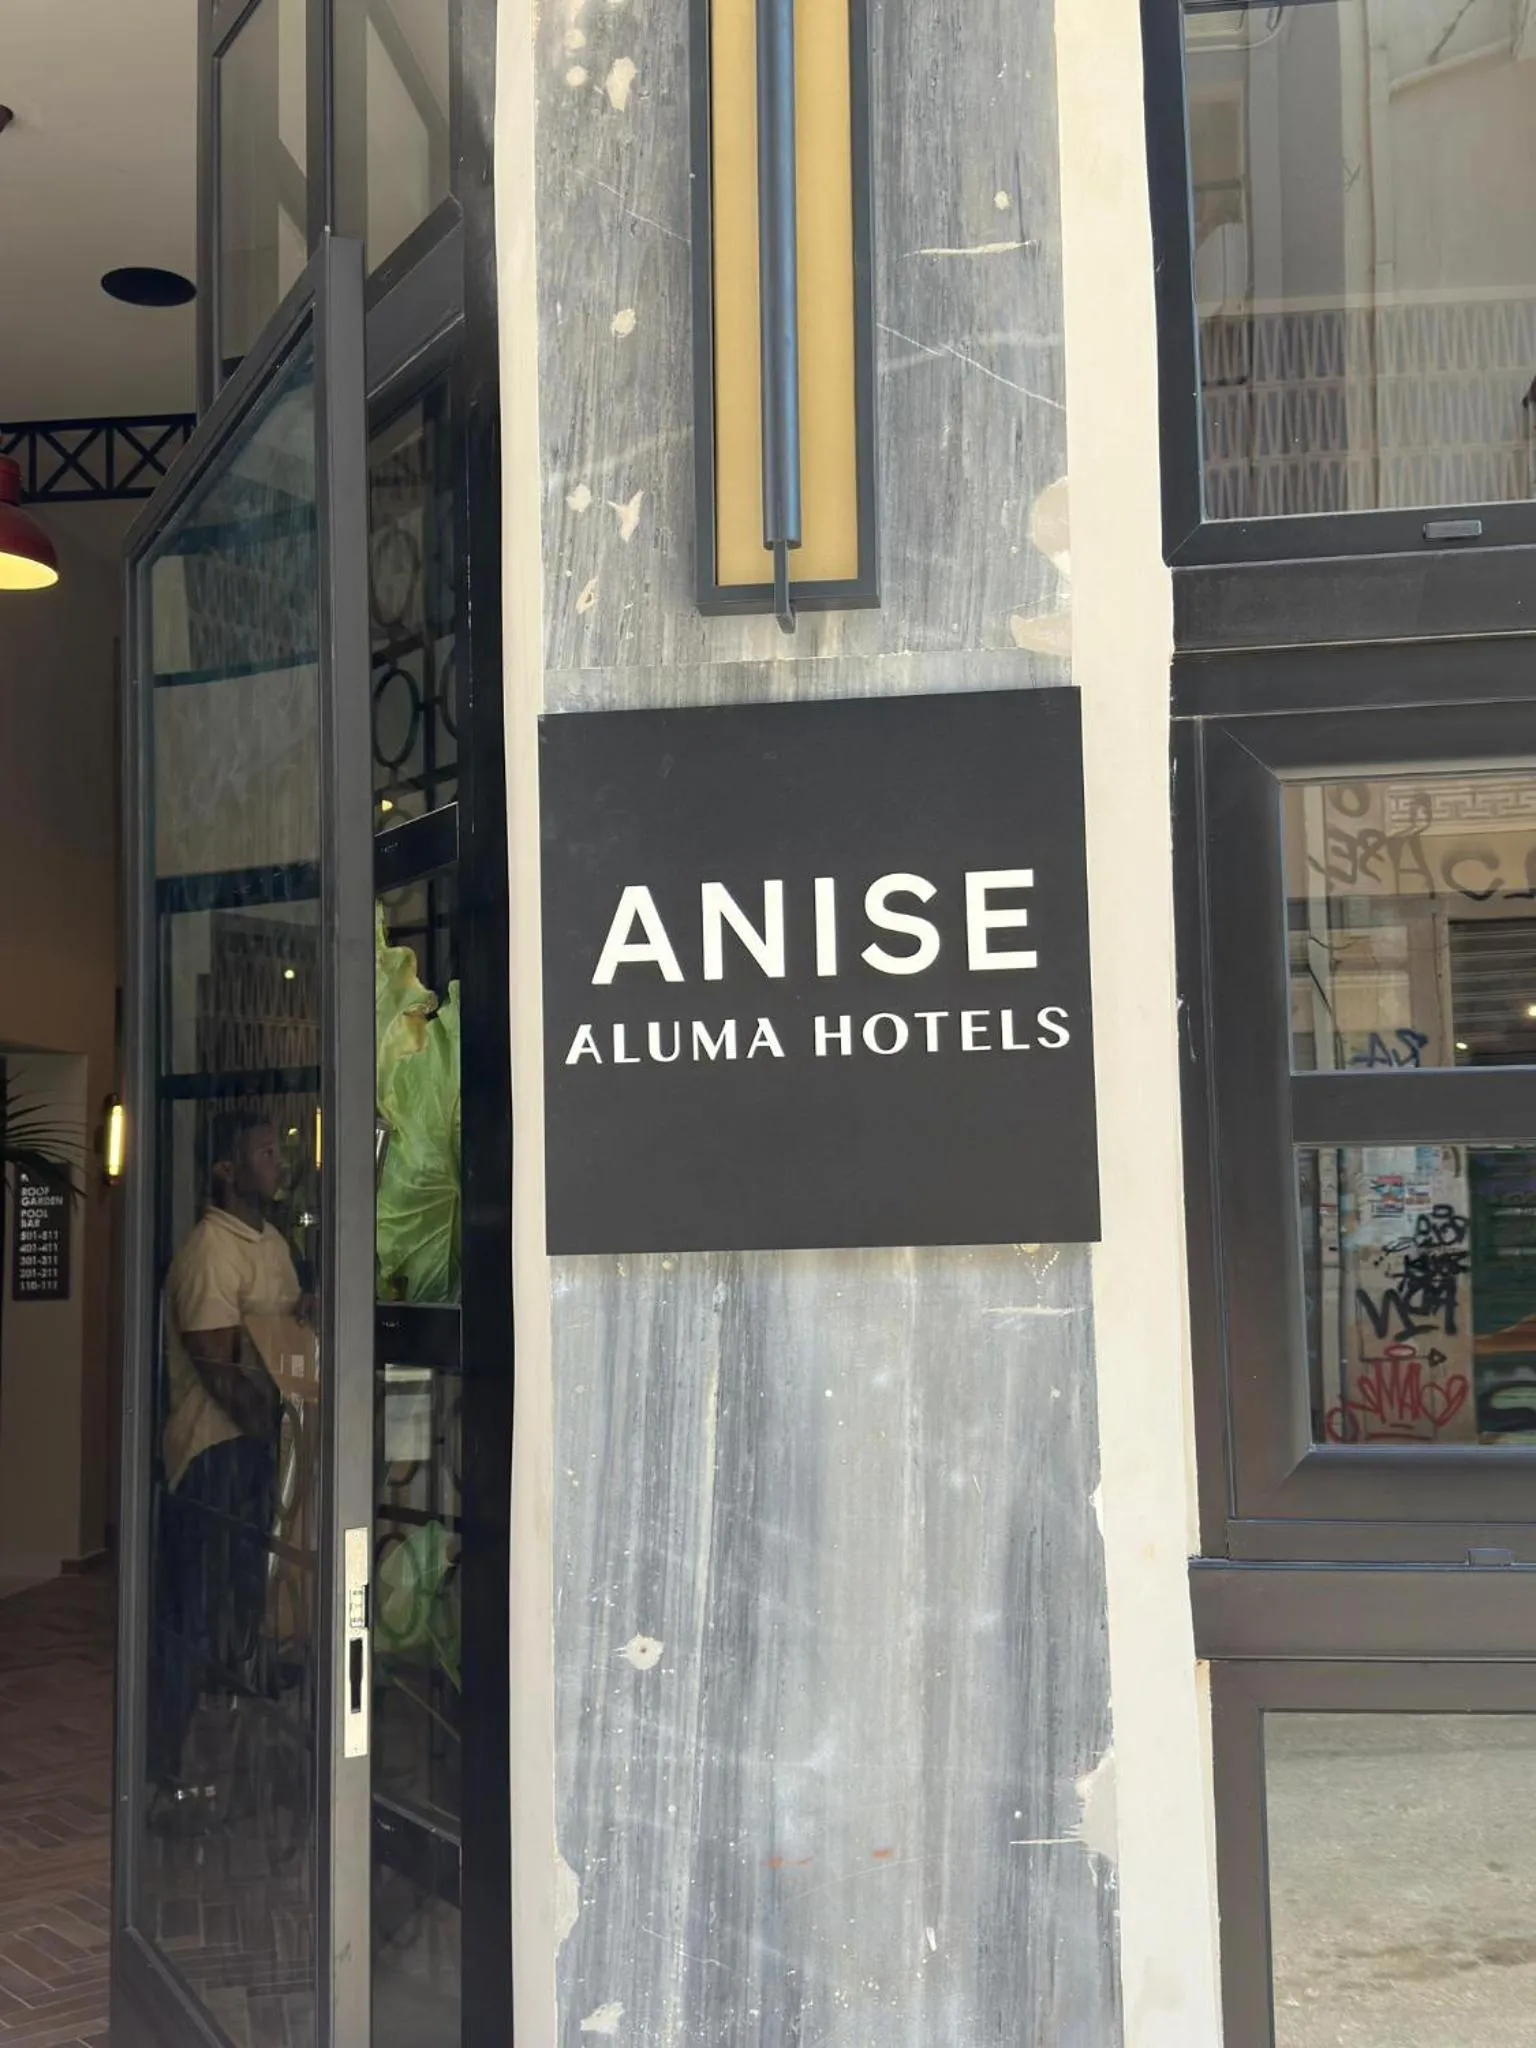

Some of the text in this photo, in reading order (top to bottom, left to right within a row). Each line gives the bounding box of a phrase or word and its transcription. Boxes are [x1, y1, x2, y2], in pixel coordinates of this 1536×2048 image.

[592, 869, 1038, 985] ANISE
[565, 1006, 1070, 1064] ALUMA HOTELS
[21, 1187, 50, 1196] ROOF
[21, 1197, 63, 1206] GARDEN
[20, 1209, 48, 1219] POOL
[20, 1219, 41, 1228] BAR
[19, 1243, 59, 1253] 401-411
[19, 1256, 59, 1266] 301-311
[19, 1268, 59, 1278] 201-211
